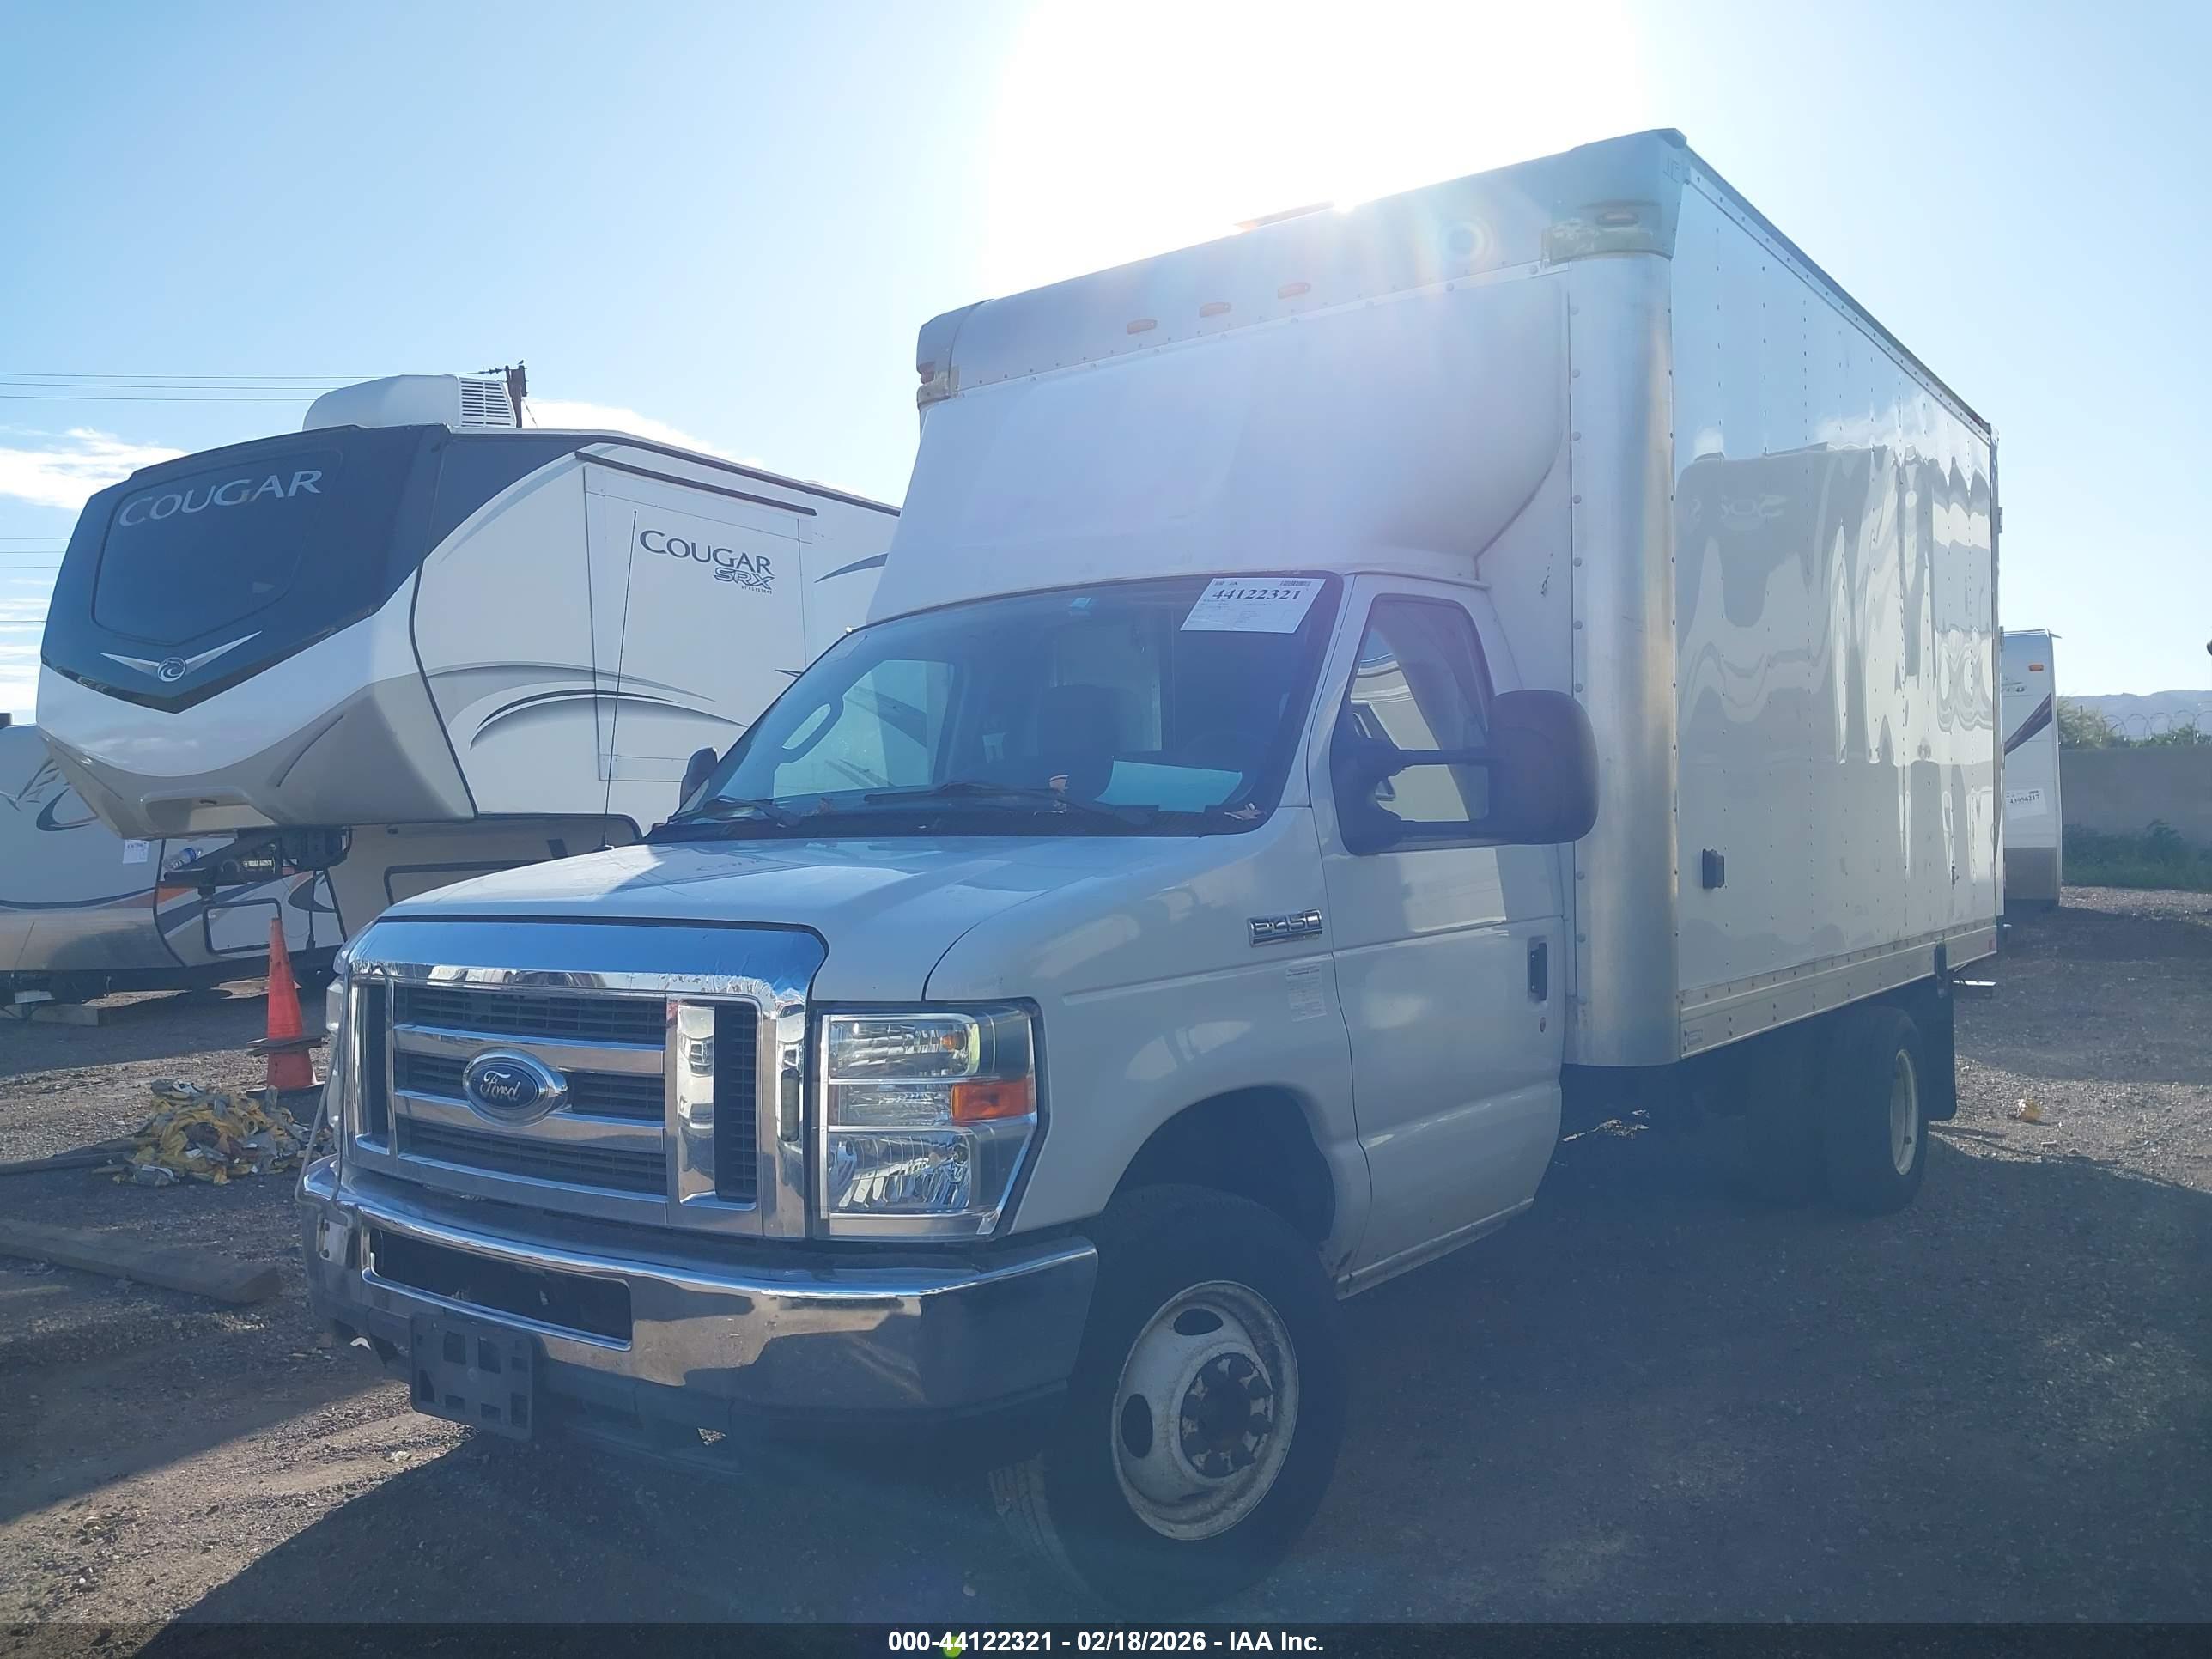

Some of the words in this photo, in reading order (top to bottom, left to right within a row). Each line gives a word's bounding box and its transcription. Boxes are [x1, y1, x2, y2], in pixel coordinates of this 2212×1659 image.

[119, 470, 323, 526] COUGAR
[639, 530, 775, 576] COUGAR
[714, 567, 775, 590] SRX
[1212, 588, 1302, 600] 44122321
[480, 1070, 521, 1101] Ford
